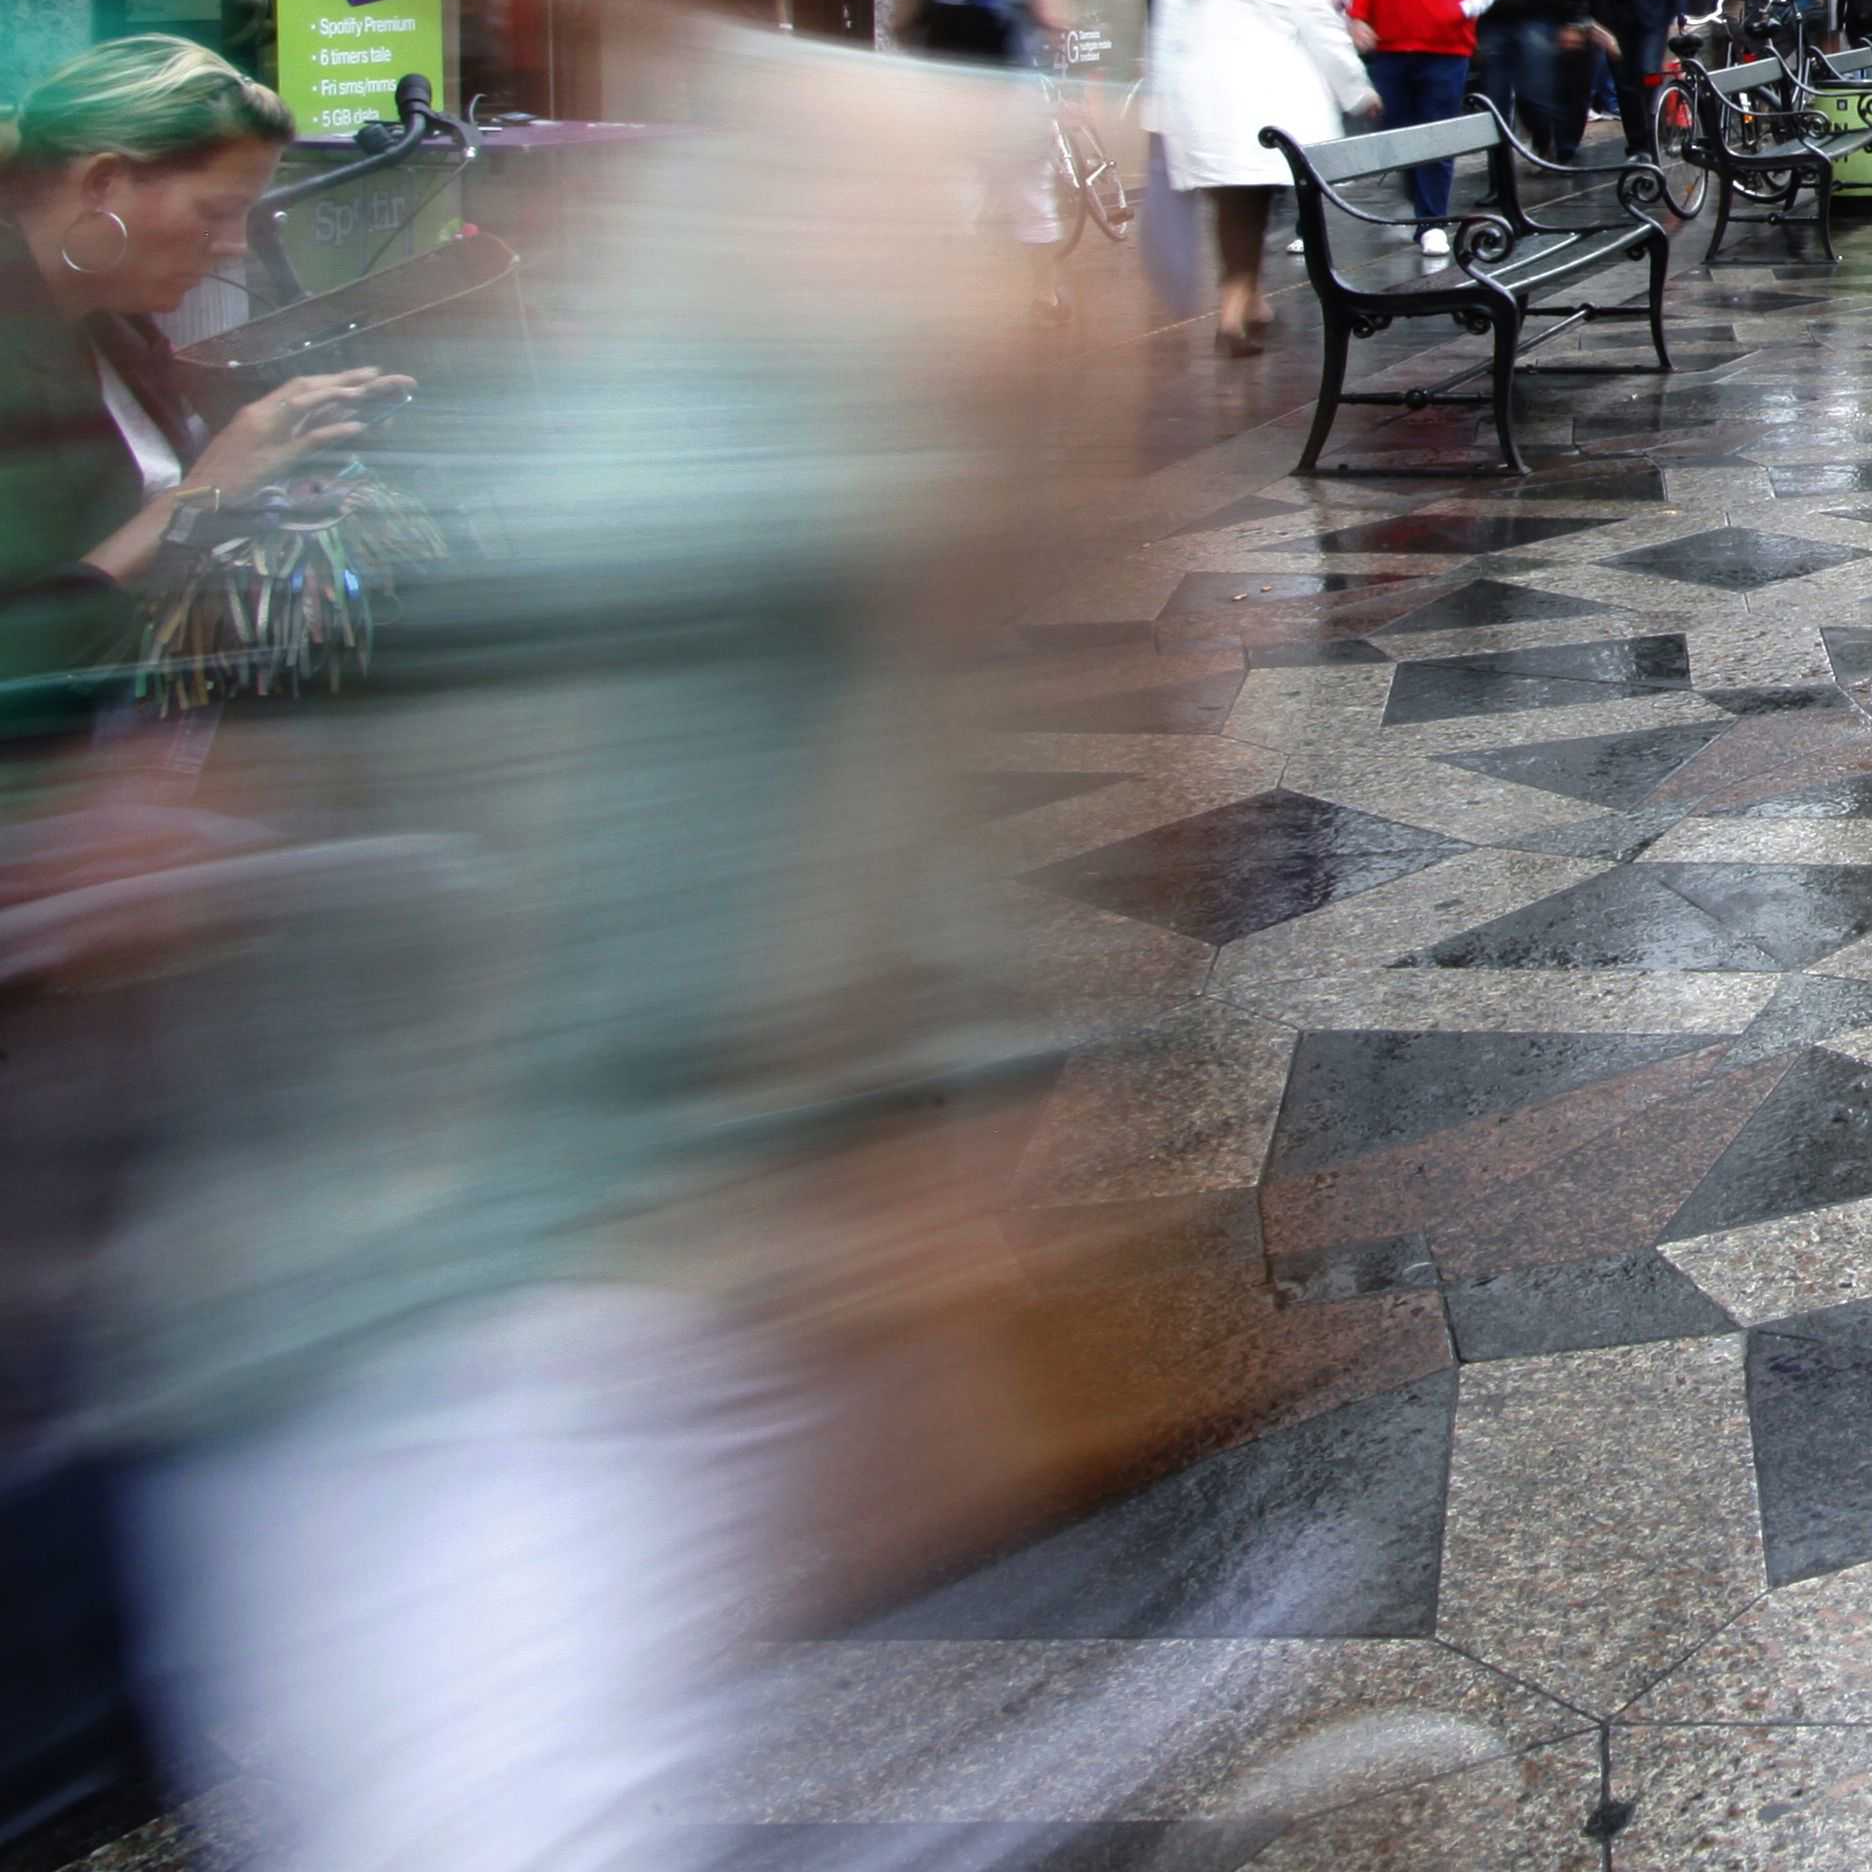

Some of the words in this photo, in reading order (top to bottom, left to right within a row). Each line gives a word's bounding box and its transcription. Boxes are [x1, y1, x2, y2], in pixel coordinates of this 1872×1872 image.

[319, 17, 363, 38] Spotify
[363, 15, 416, 33] Premium
[320, 49, 329, 66] 6
[330, 48, 369, 65] timers
[370, 46, 392, 63] tale
[320, 79, 338, 96] Fri
[321, 110, 331, 127] 5
